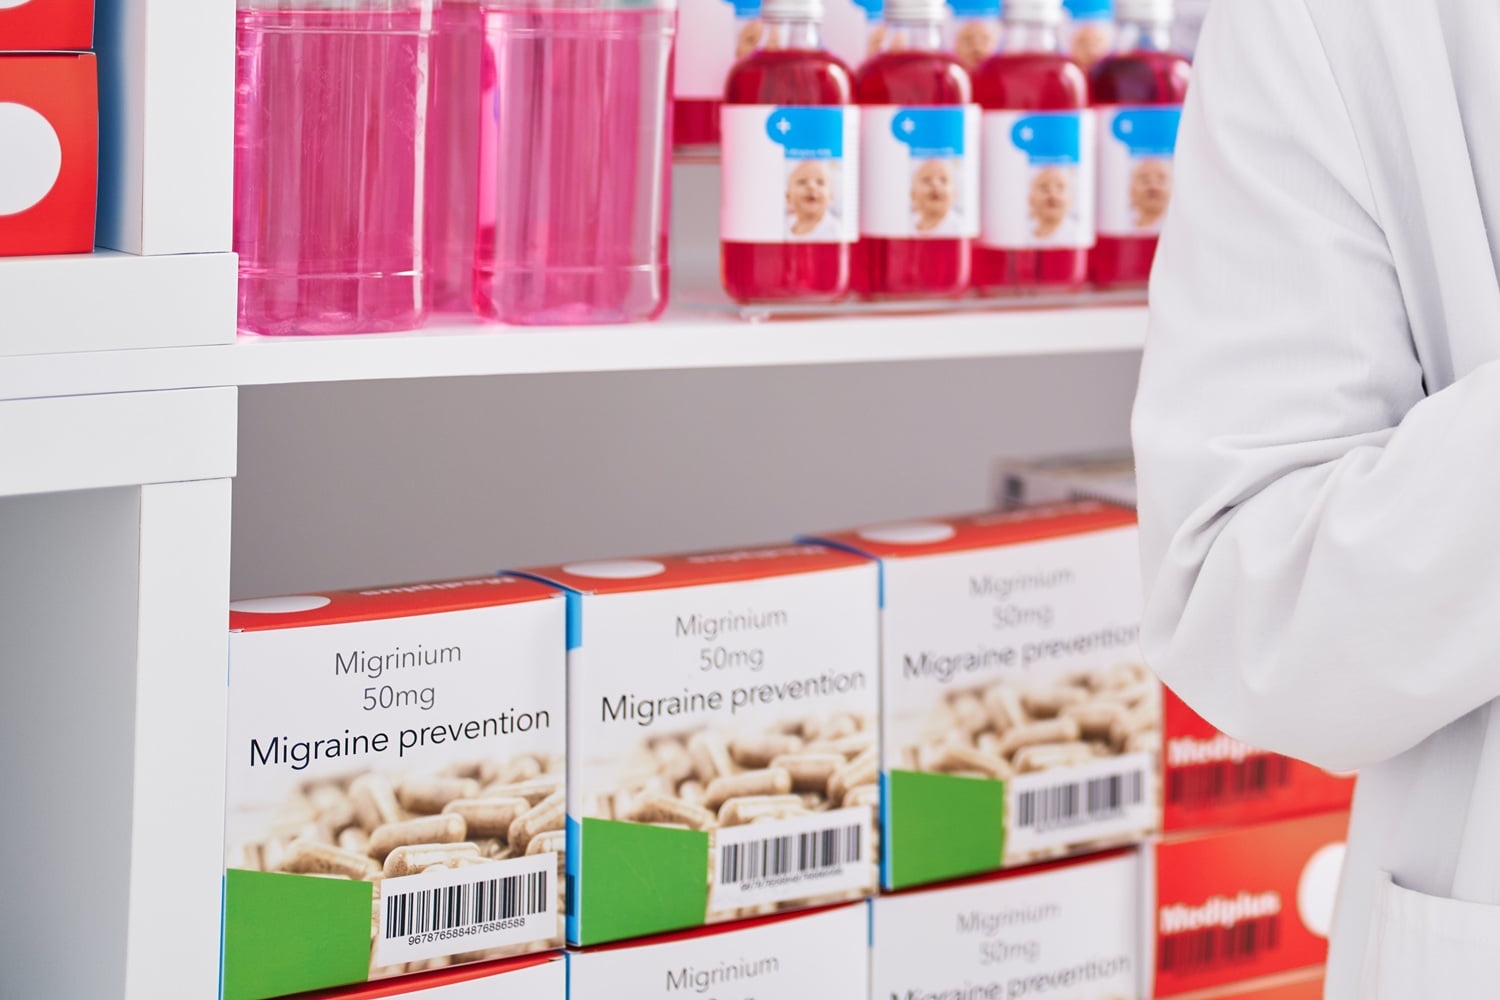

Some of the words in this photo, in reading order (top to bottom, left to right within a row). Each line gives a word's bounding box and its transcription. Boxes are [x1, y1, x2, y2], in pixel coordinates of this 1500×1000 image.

[674, 607, 788, 642] Migrinium
[335, 644, 463, 679] Migrinium
[699, 645, 765, 674] 50mg
[903, 643, 1018, 683] Migraine
[362, 684, 436, 712] 50mg
[600, 687, 723, 727] Migraine
[731, 669, 866, 715] prevention
[249, 728, 389, 771] Migraine
[398, 707, 551, 757] prevention
[1160, 891, 1281, 934] Mediplus
[666, 957, 780, 994] Migrinium
